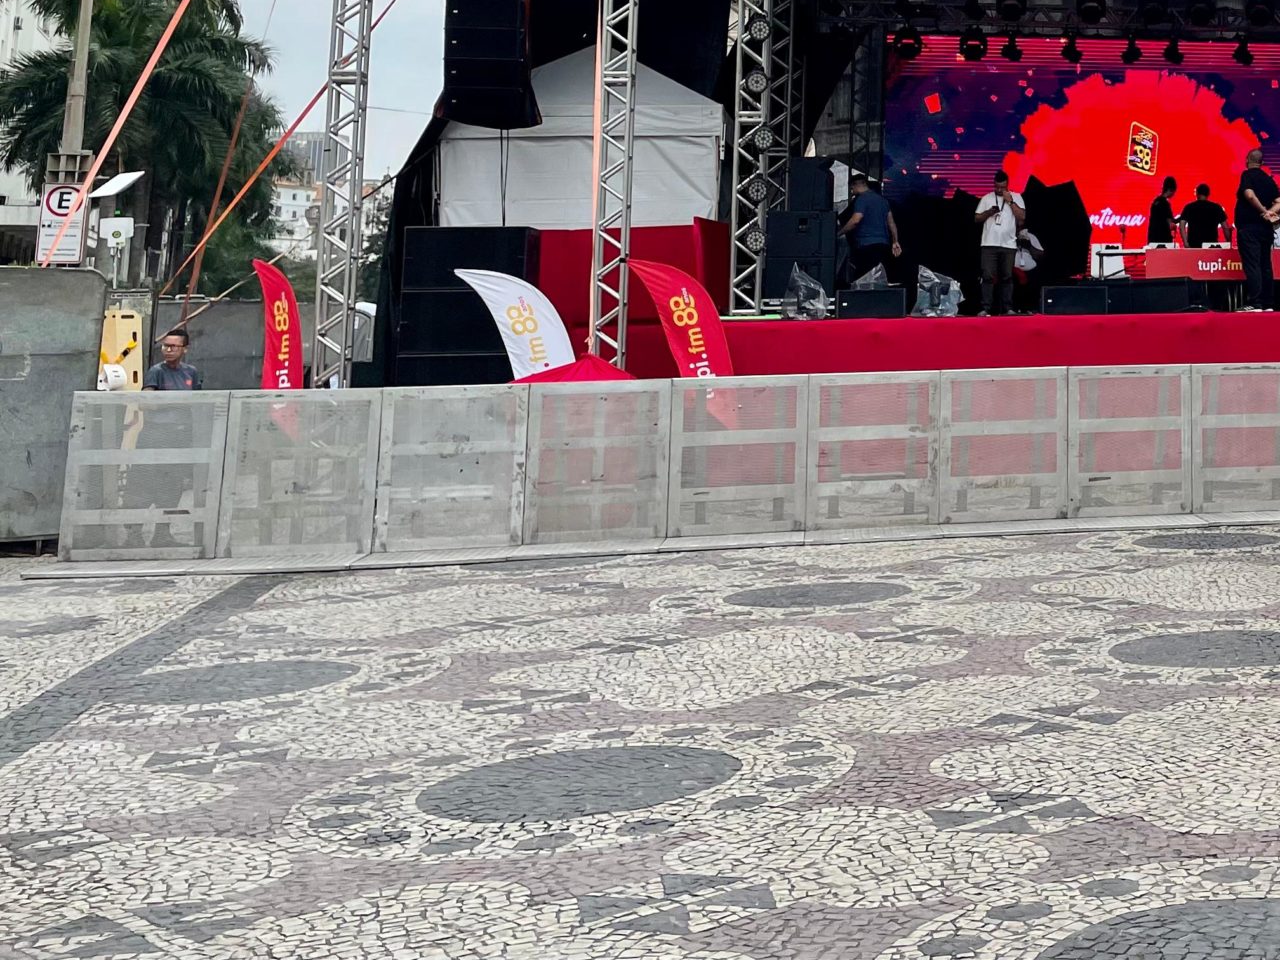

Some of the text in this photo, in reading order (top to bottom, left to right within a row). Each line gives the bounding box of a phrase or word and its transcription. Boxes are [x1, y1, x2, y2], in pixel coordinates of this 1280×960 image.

[57, 191, 72, 209] E
[1089, 207, 1146, 229] ntinua
[1198, 258, 1244, 273] tupi.fm
